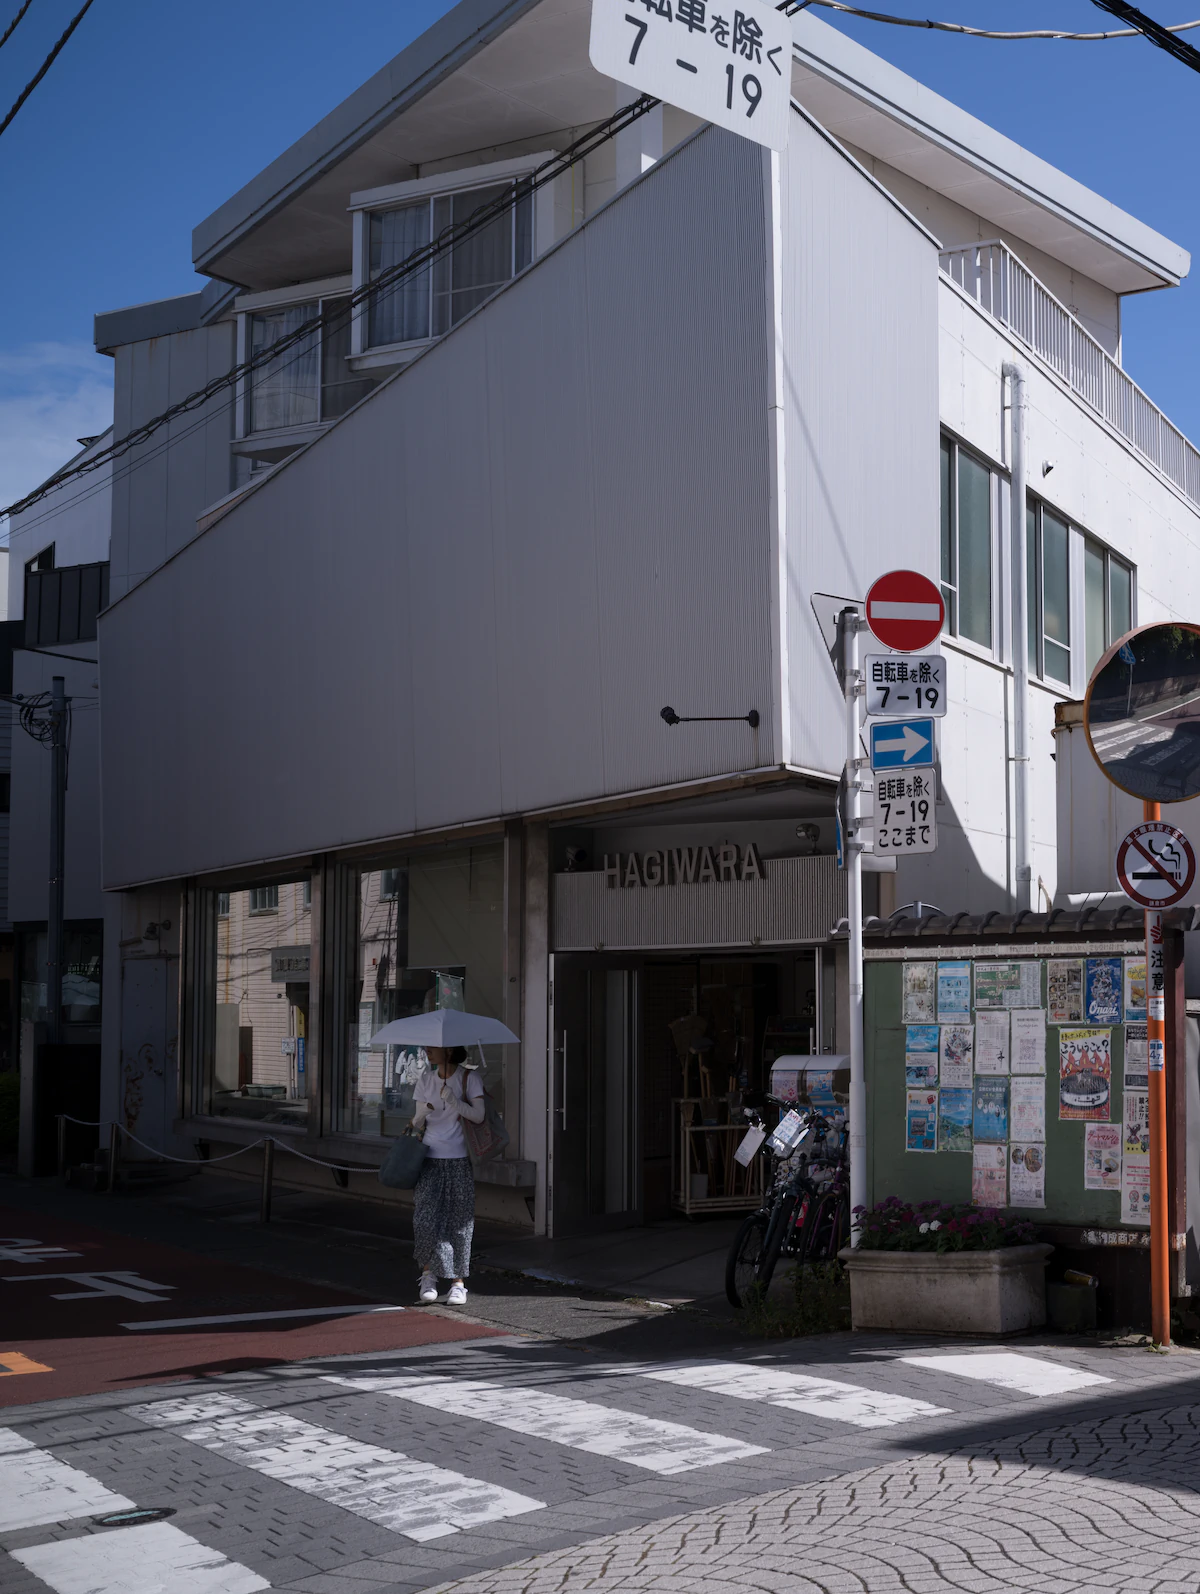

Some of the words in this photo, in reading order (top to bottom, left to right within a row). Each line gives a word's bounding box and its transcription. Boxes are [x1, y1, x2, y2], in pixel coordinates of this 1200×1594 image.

[625, 14, 763, 119] 7-19
[872, 661, 940, 684] 自転車を除く
[876, 686, 939, 709] 7-19
[878, 775, 930, 801] 自転車を除く
[880, 799, 929, 825] 7-19
[878, 825, 931, 848] ここまで
[603, 843, 763, 889] HAGIWARA
[1089, 997, 1118, 1019] Onari
